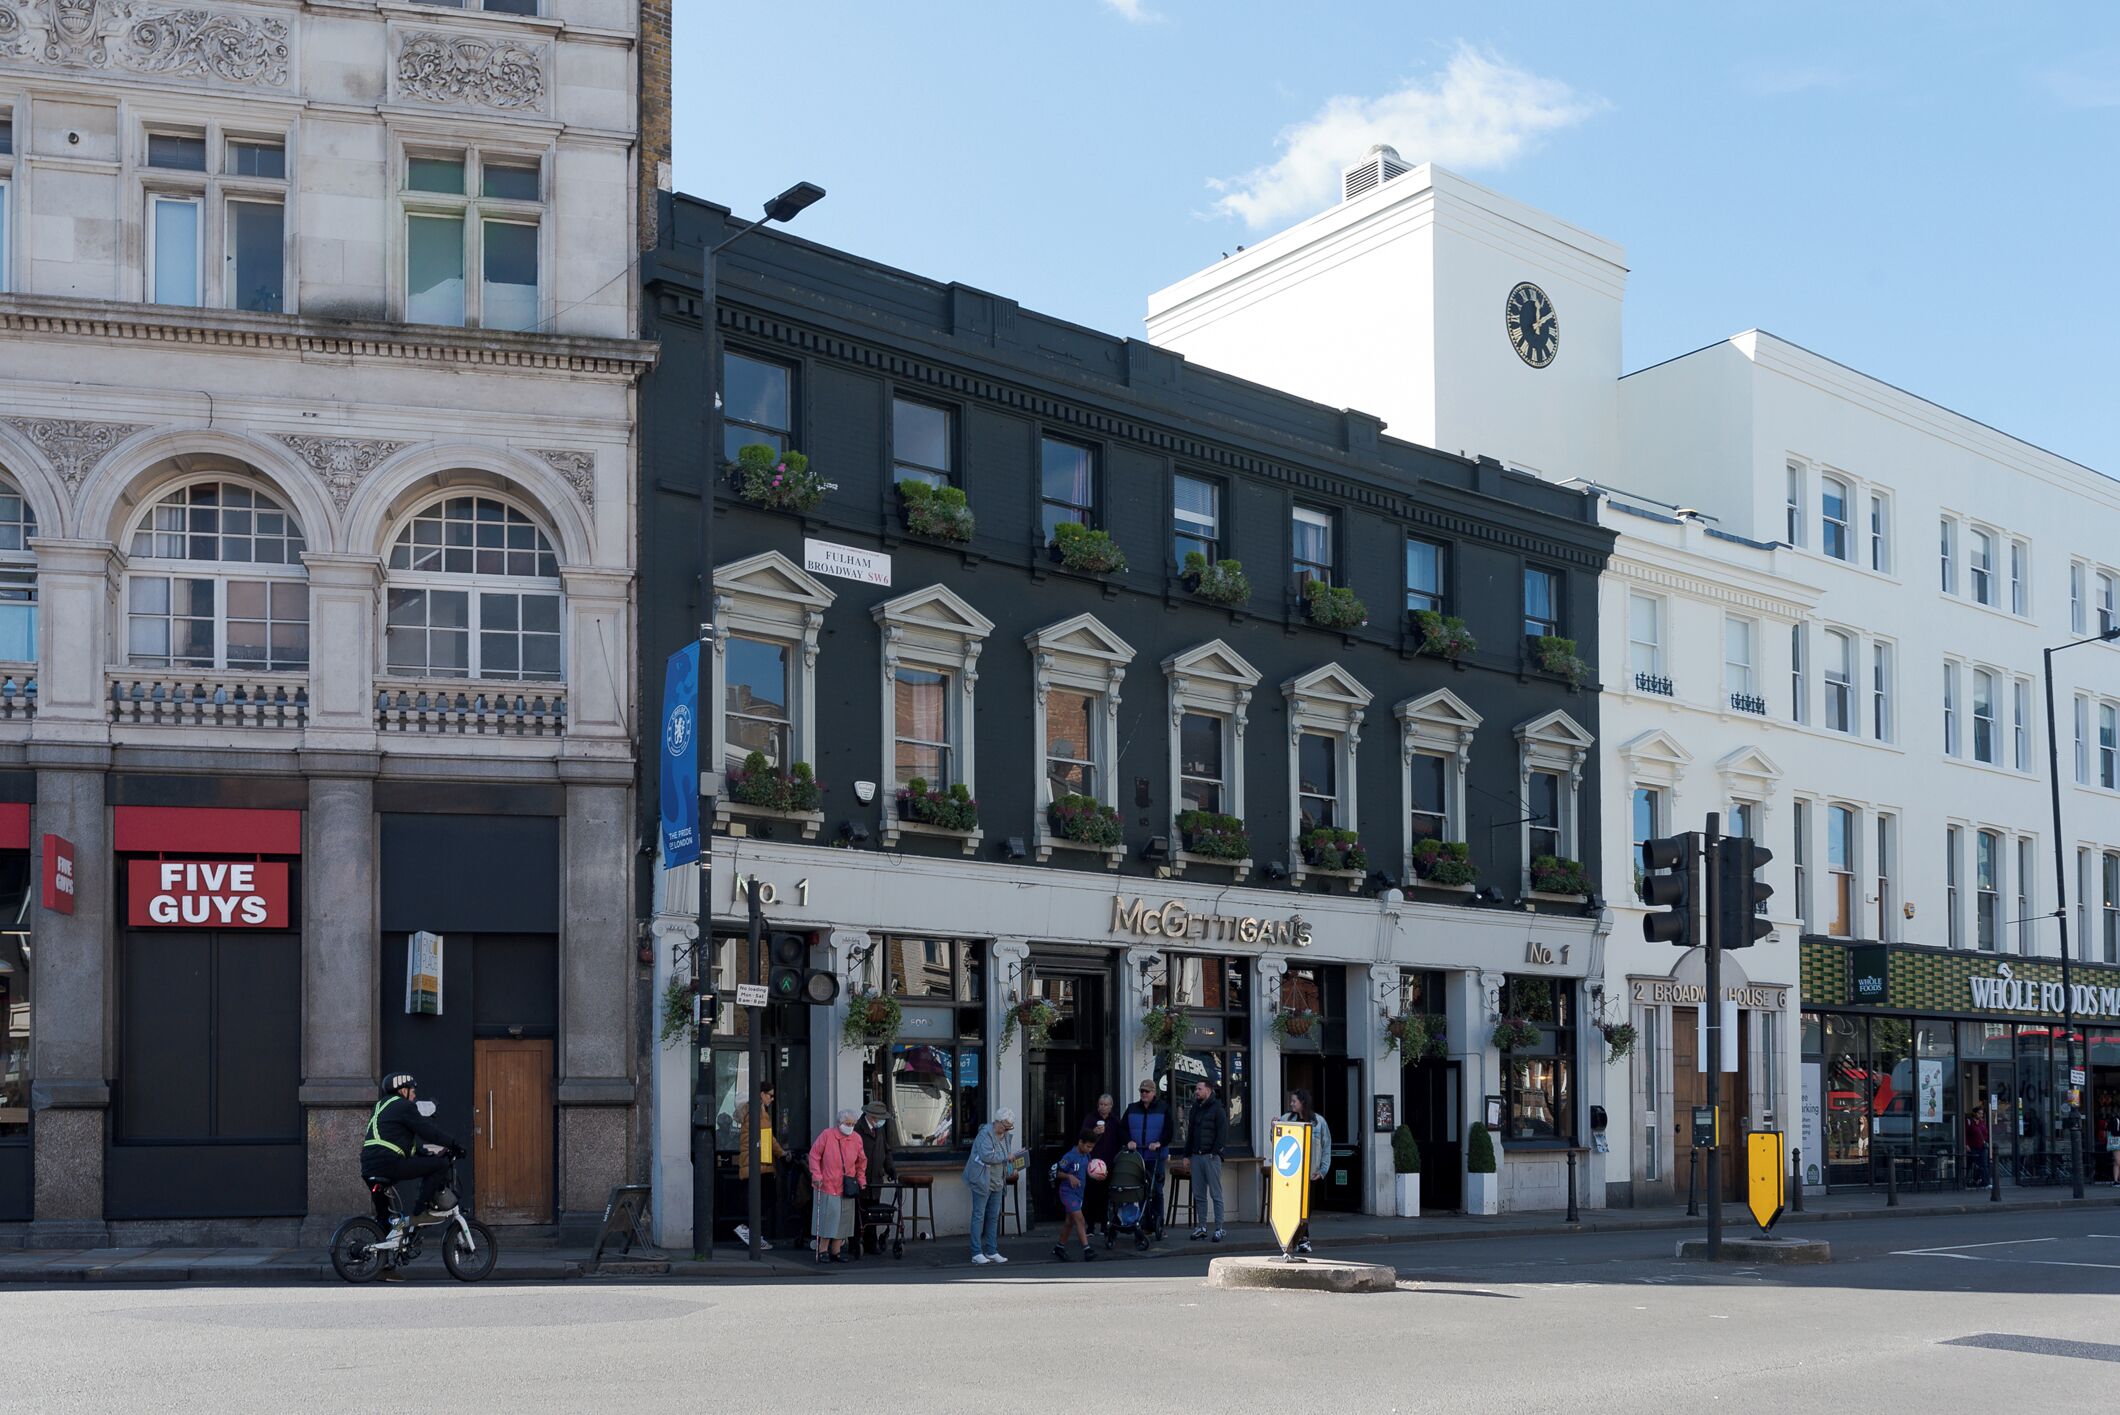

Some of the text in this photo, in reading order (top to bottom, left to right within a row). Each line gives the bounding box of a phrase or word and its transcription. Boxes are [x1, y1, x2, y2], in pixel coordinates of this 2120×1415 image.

[826, 551, 871, 569] FULHAM
[808, 560, 889, 584] BROADWAY SW6
[668, 827, 692, 840] THE PRIDE
[674, 837, 693, 849] LONDON
[57, 855, 73, 877] FIVE
[55, 873, 74, 896] GUYS
[161, 863, 255, 892] FIVE
[795, 878, 809, 906] 1
[149, 895, 268, 925] GUYS
[1560, 944, 1571, 965] 1
[1858, 977, 1882, 986] WHOLE
[1859, 984, 1882, 992] FOODS
[1968, 972, 2039, 1011] WHOLE
[1633, 982, 1787, 1008] 2 BROADW HOUSE 6
